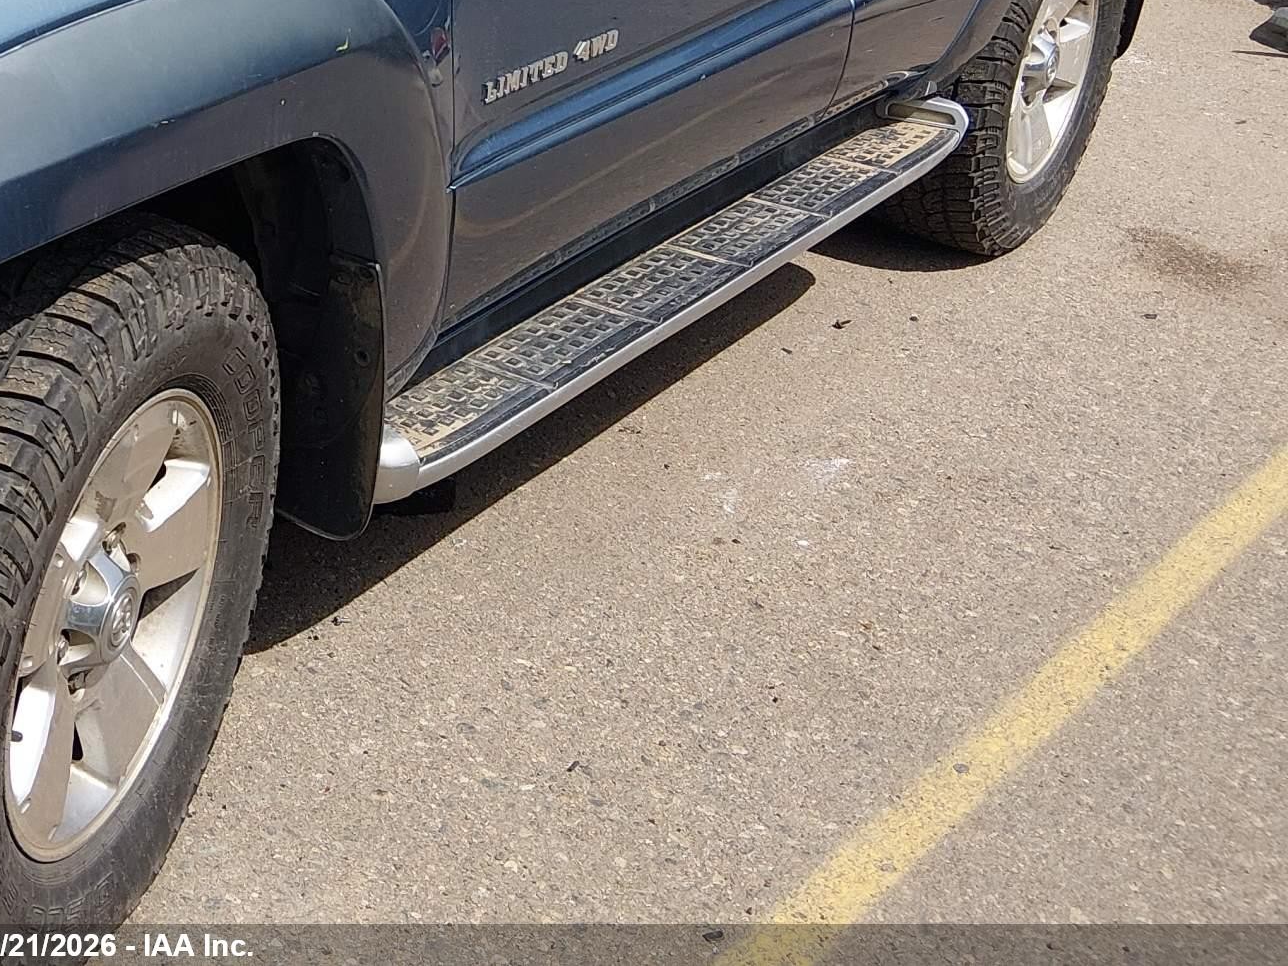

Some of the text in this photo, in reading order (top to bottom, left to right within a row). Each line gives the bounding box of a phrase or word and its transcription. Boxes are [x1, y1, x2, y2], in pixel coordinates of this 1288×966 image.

[483, 28, 619, 105] LIMITED 4WD
[222, 346, 266, 529] COOPER
